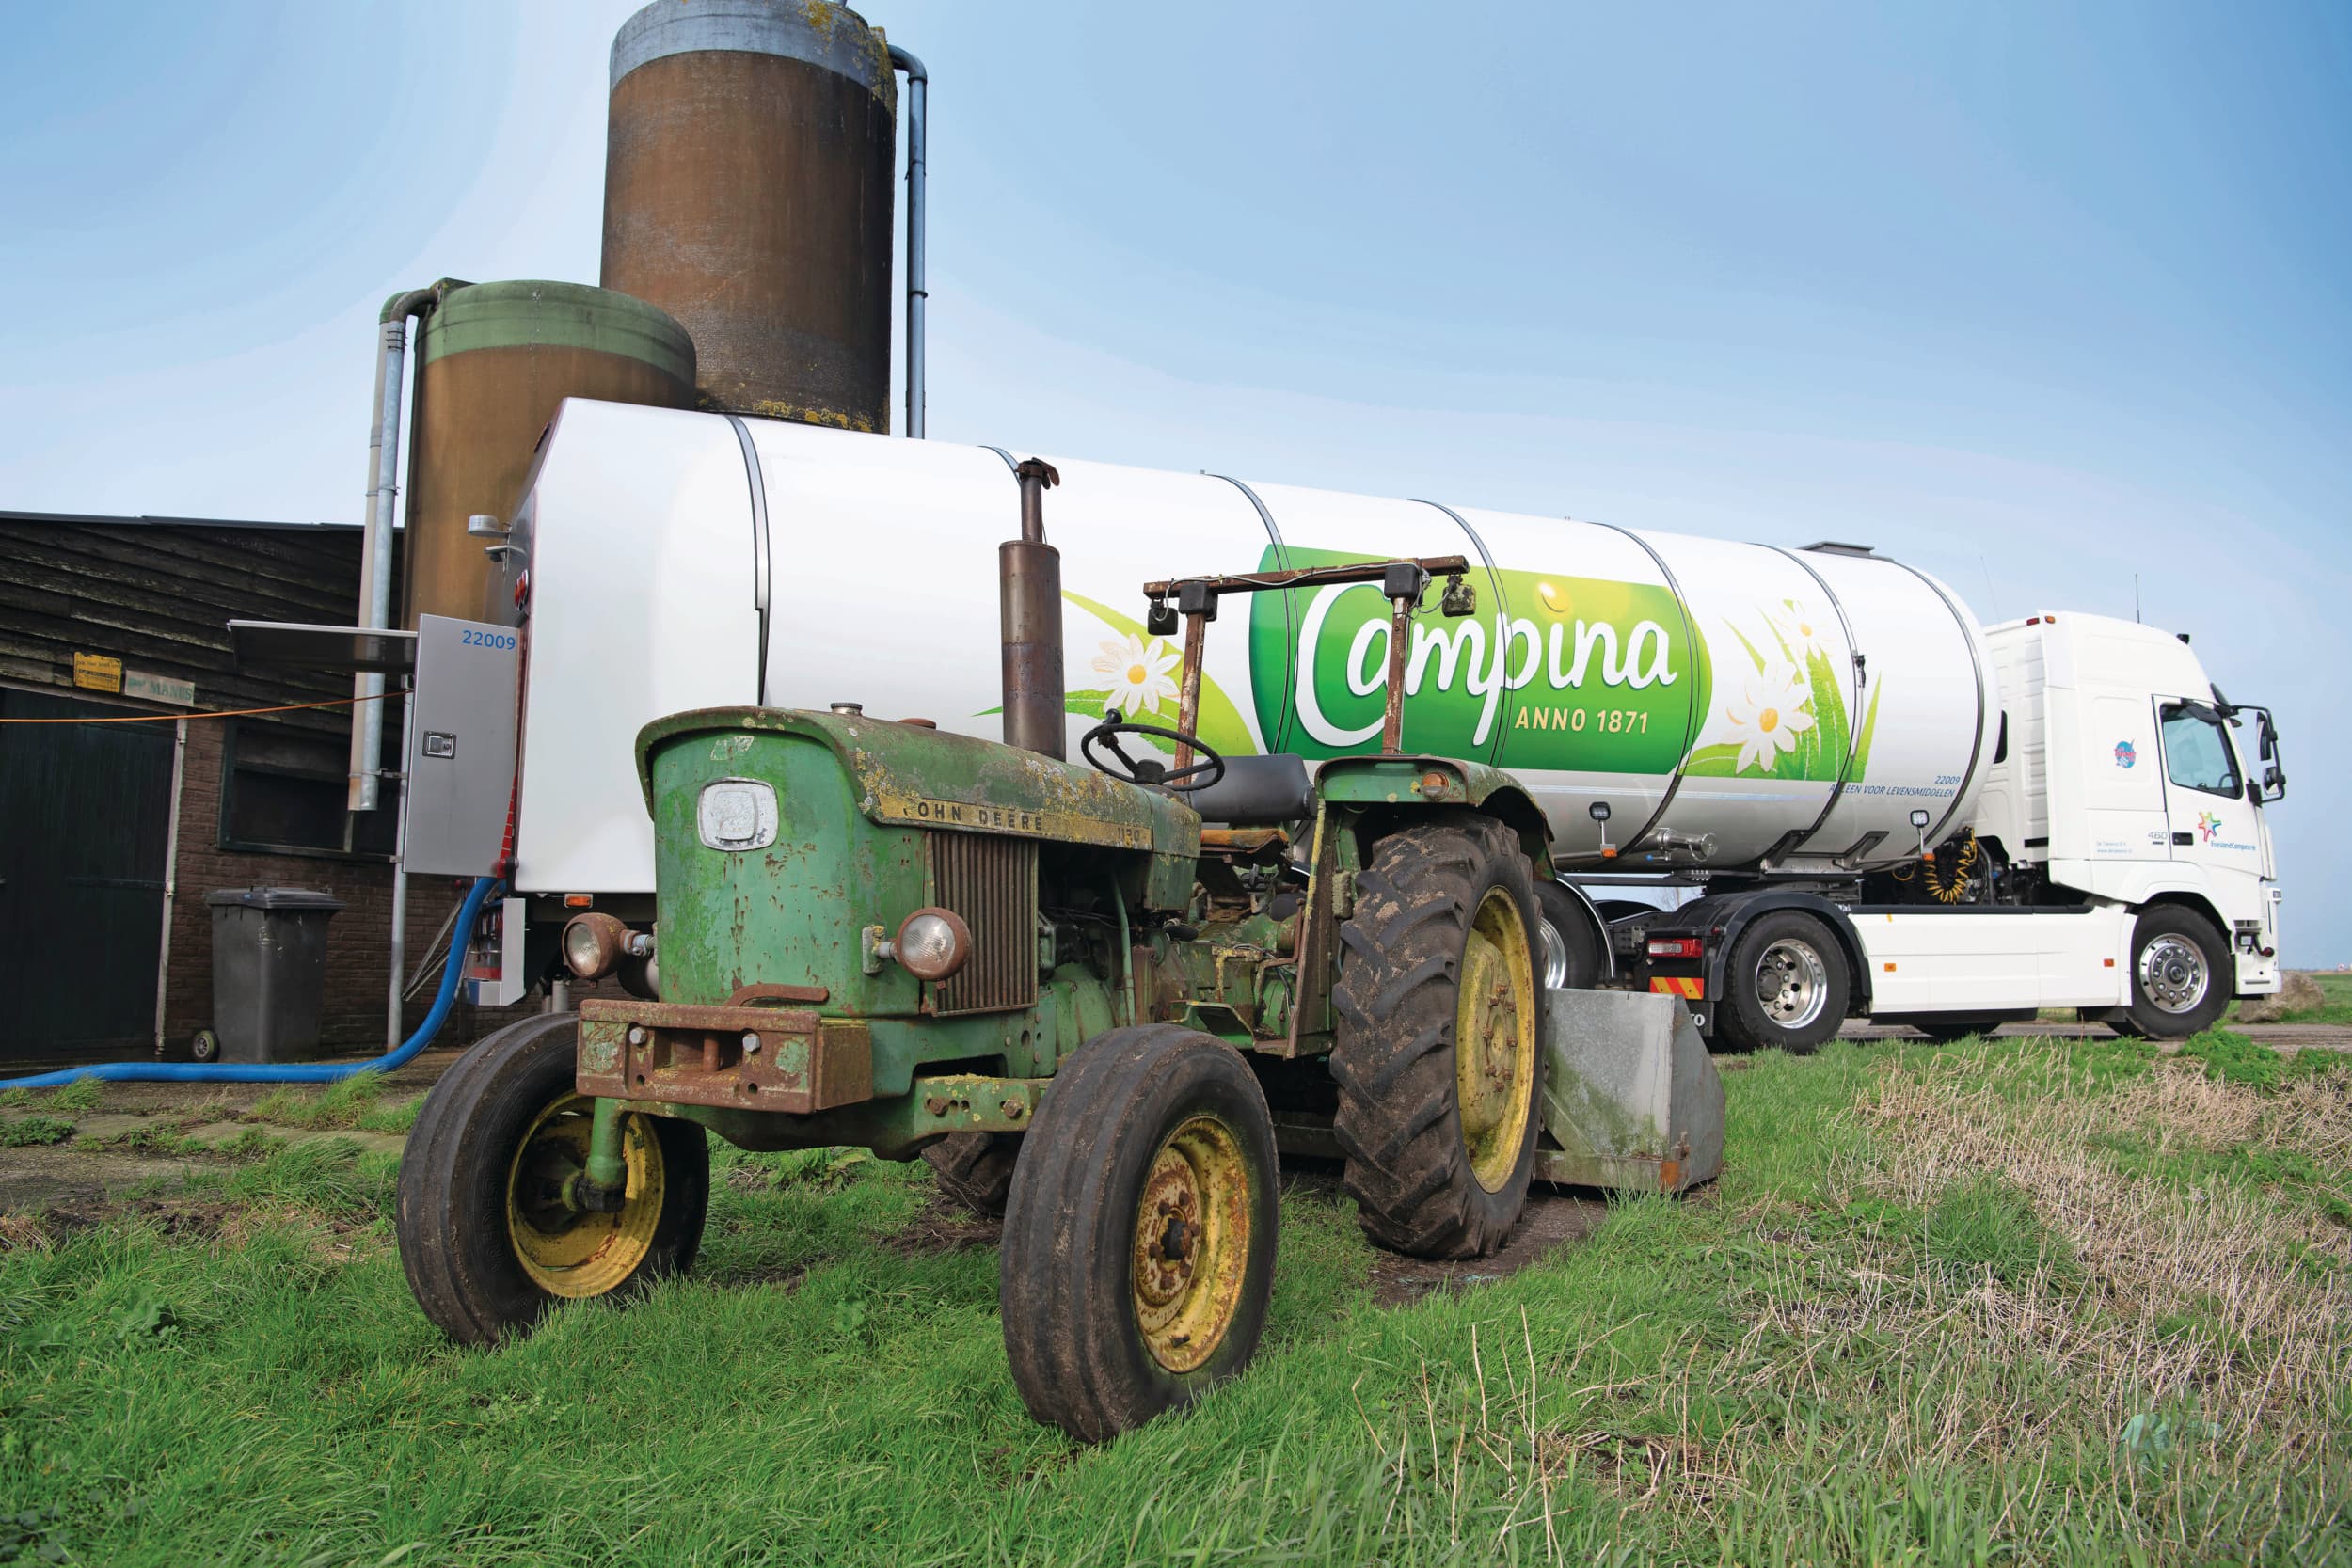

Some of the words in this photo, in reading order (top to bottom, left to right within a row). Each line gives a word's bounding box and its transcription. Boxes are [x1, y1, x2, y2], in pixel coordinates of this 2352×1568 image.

[462, 629, 516, 650] 22009
[1295, 582, 1677, 747] Campina
[1514, 706, 1586, 731] ANNO
[1597, 709, 1648, 734] 1871
[1829, 784, 1862, 795] AEEN
[1863, 785, 1886, 795] VOOR
[1886, 787, 1956, 798] LEVENSMIDDELEN
[1934, 775, 1961, 784] 22009
[903, 801, 961, 821] OHN
[978, 809, 1042, 831] DEERE
